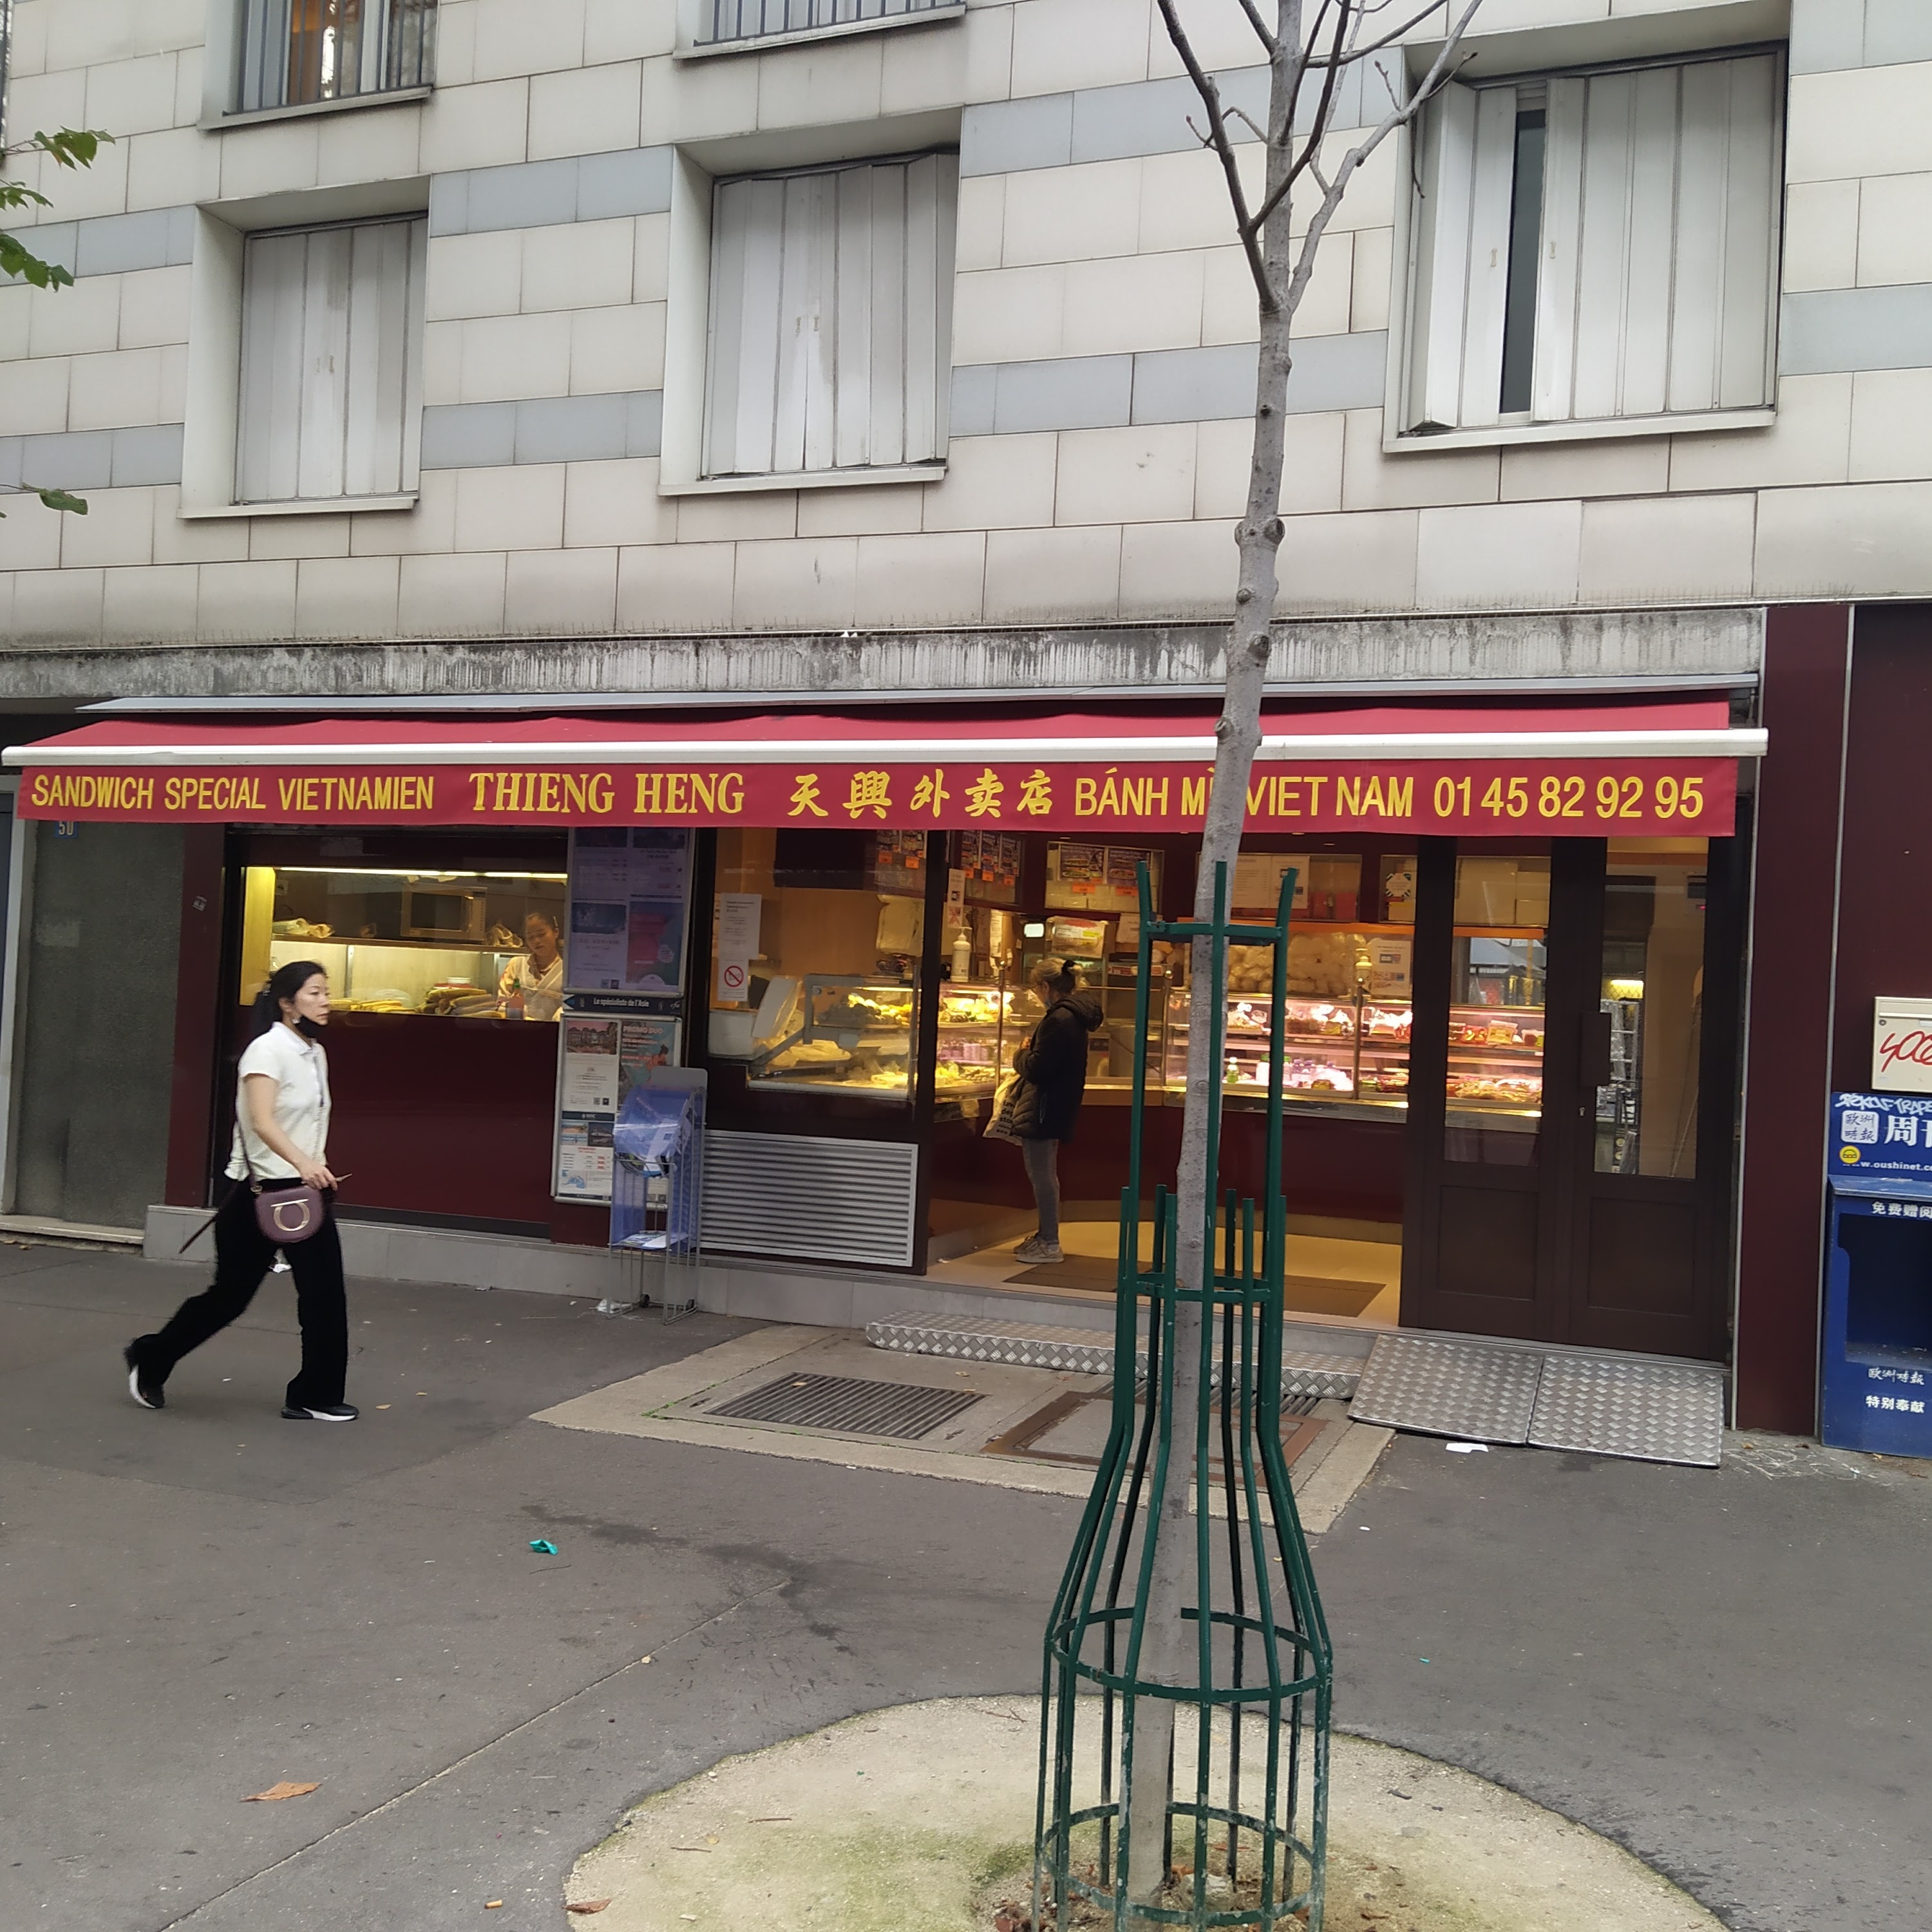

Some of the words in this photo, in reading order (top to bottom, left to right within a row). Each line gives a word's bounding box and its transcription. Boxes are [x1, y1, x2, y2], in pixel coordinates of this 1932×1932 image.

[32, 775, 154, 810] SANDWICH
[164, 777, 266, 810] SPECIAL
[278, 776, 434, 811] VIETNAMIEN
[469, 772, 615, 813] THIENG
[634, 773, 745, 813] HENG
[1075, 766, 1169, 816] BÁNH
[1245, 776, 1328, 816] VIET
[1336, 775, 1414, 817] NAM
[1434, 776, 1472, 817] 01
[1481, 777, 1529, 817] 45
[1538, 776, 1586, 817] 82
[1595, 776, 1644, 819] 92
[1654, 776, 1704, 819] 95
